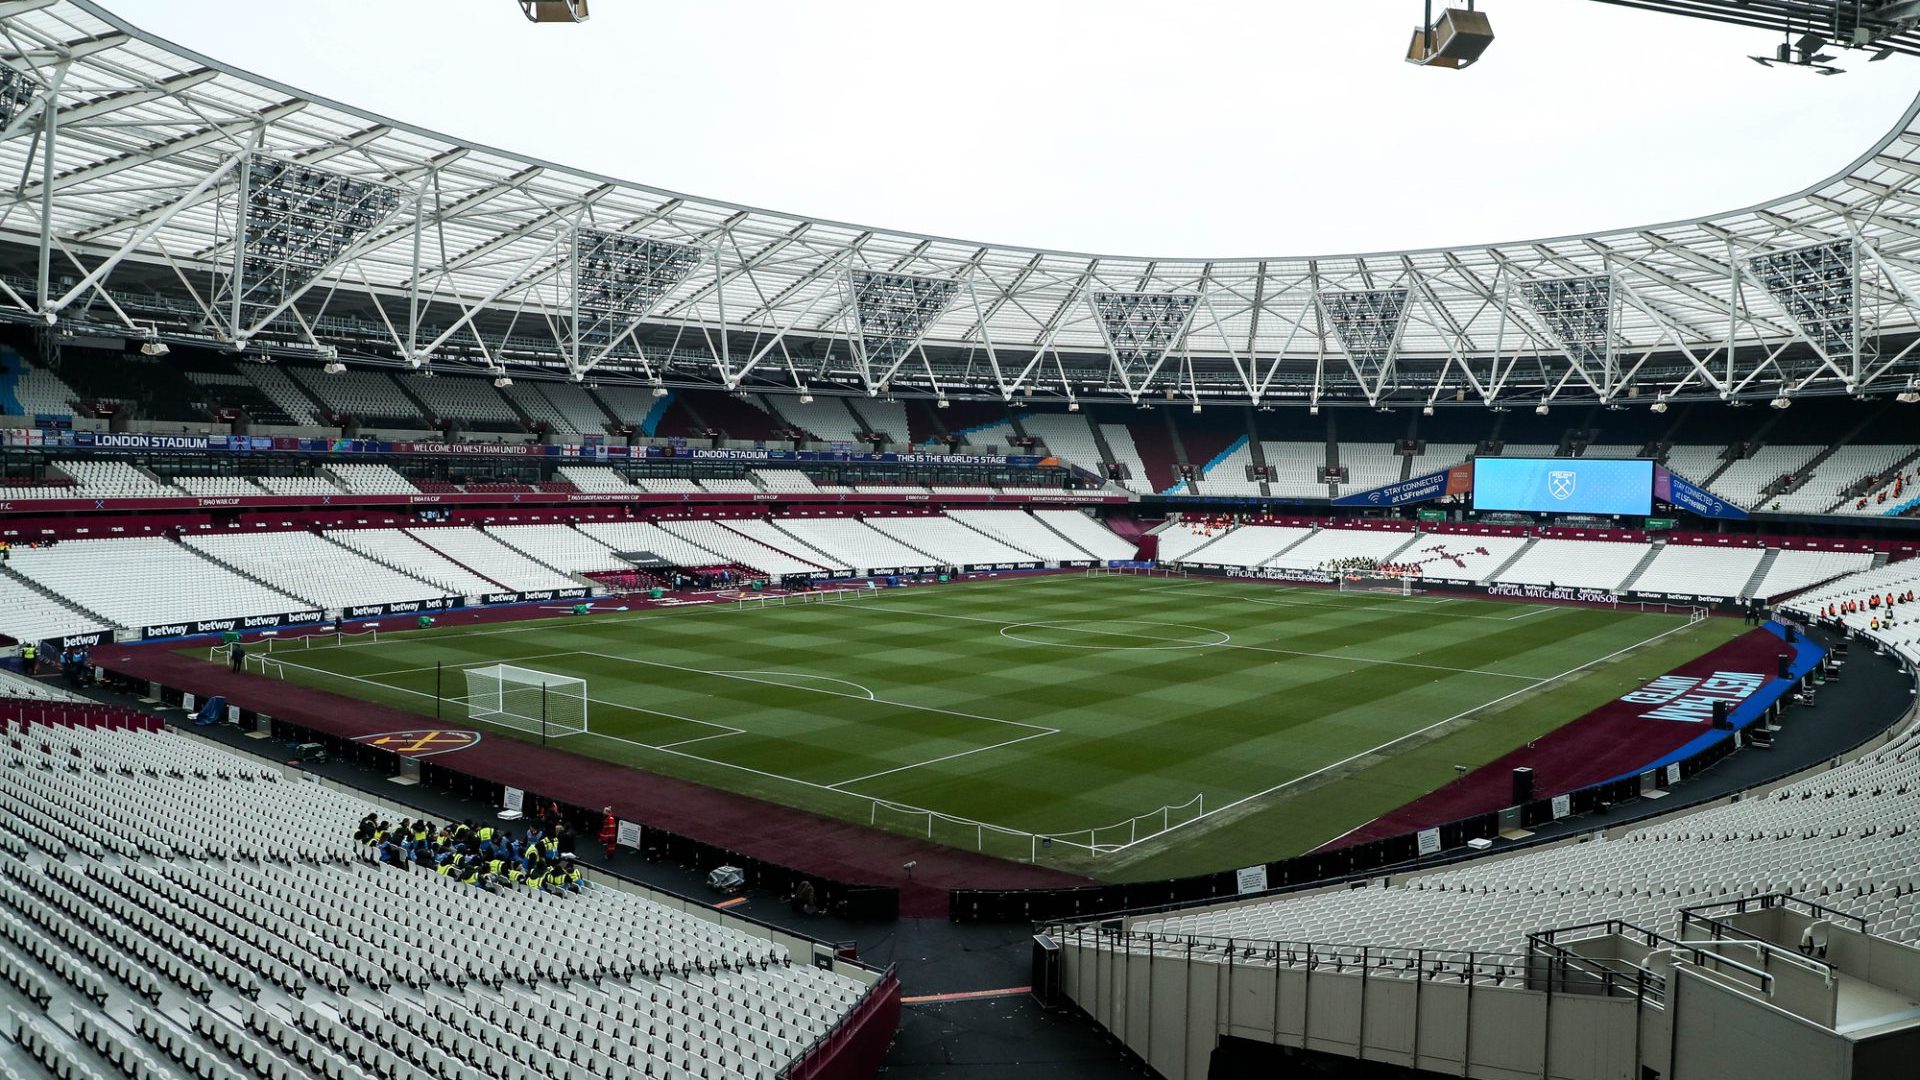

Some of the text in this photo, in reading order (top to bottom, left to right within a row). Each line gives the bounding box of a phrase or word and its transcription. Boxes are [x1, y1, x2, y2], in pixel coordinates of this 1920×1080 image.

[95, 435, 207, 448] LONDON STADIUM
[413, 443, 451, 452] WELCOME
[451, 445, 462, 453] TO
[463, 445, 482, 453] WEST
[500, 446, 526, 454] UNITED
[693, 450, 768, 460] LONDON STADIUM
[897, 454, 1007, 464] THIS IS THE WORLD'S STAGE
[1384, 474, 1444, 496] STAY CONNECTED
[1673, 479, 1713, 506] STAY CONNECTED
[1226, 569, 1255, 578] OFFICIAL
[1257, 571, 1296, 581] MATCHBALL
[1298, 574, 1329, 583] SPONSO
[489, 589, 586, 603] betway betway betway
[1488, 586, 1618, 603] OFFICIAL MATCHBALL SPONSOR
[353, 599, 454, 616] betway betway bety
[148, 611, 322, 636] betway betway betway betway
[63, 634, 100, 647] betway
[1618, 676, 1703, 705] UNITED
[1695, 671, 1766, 699] WEST
